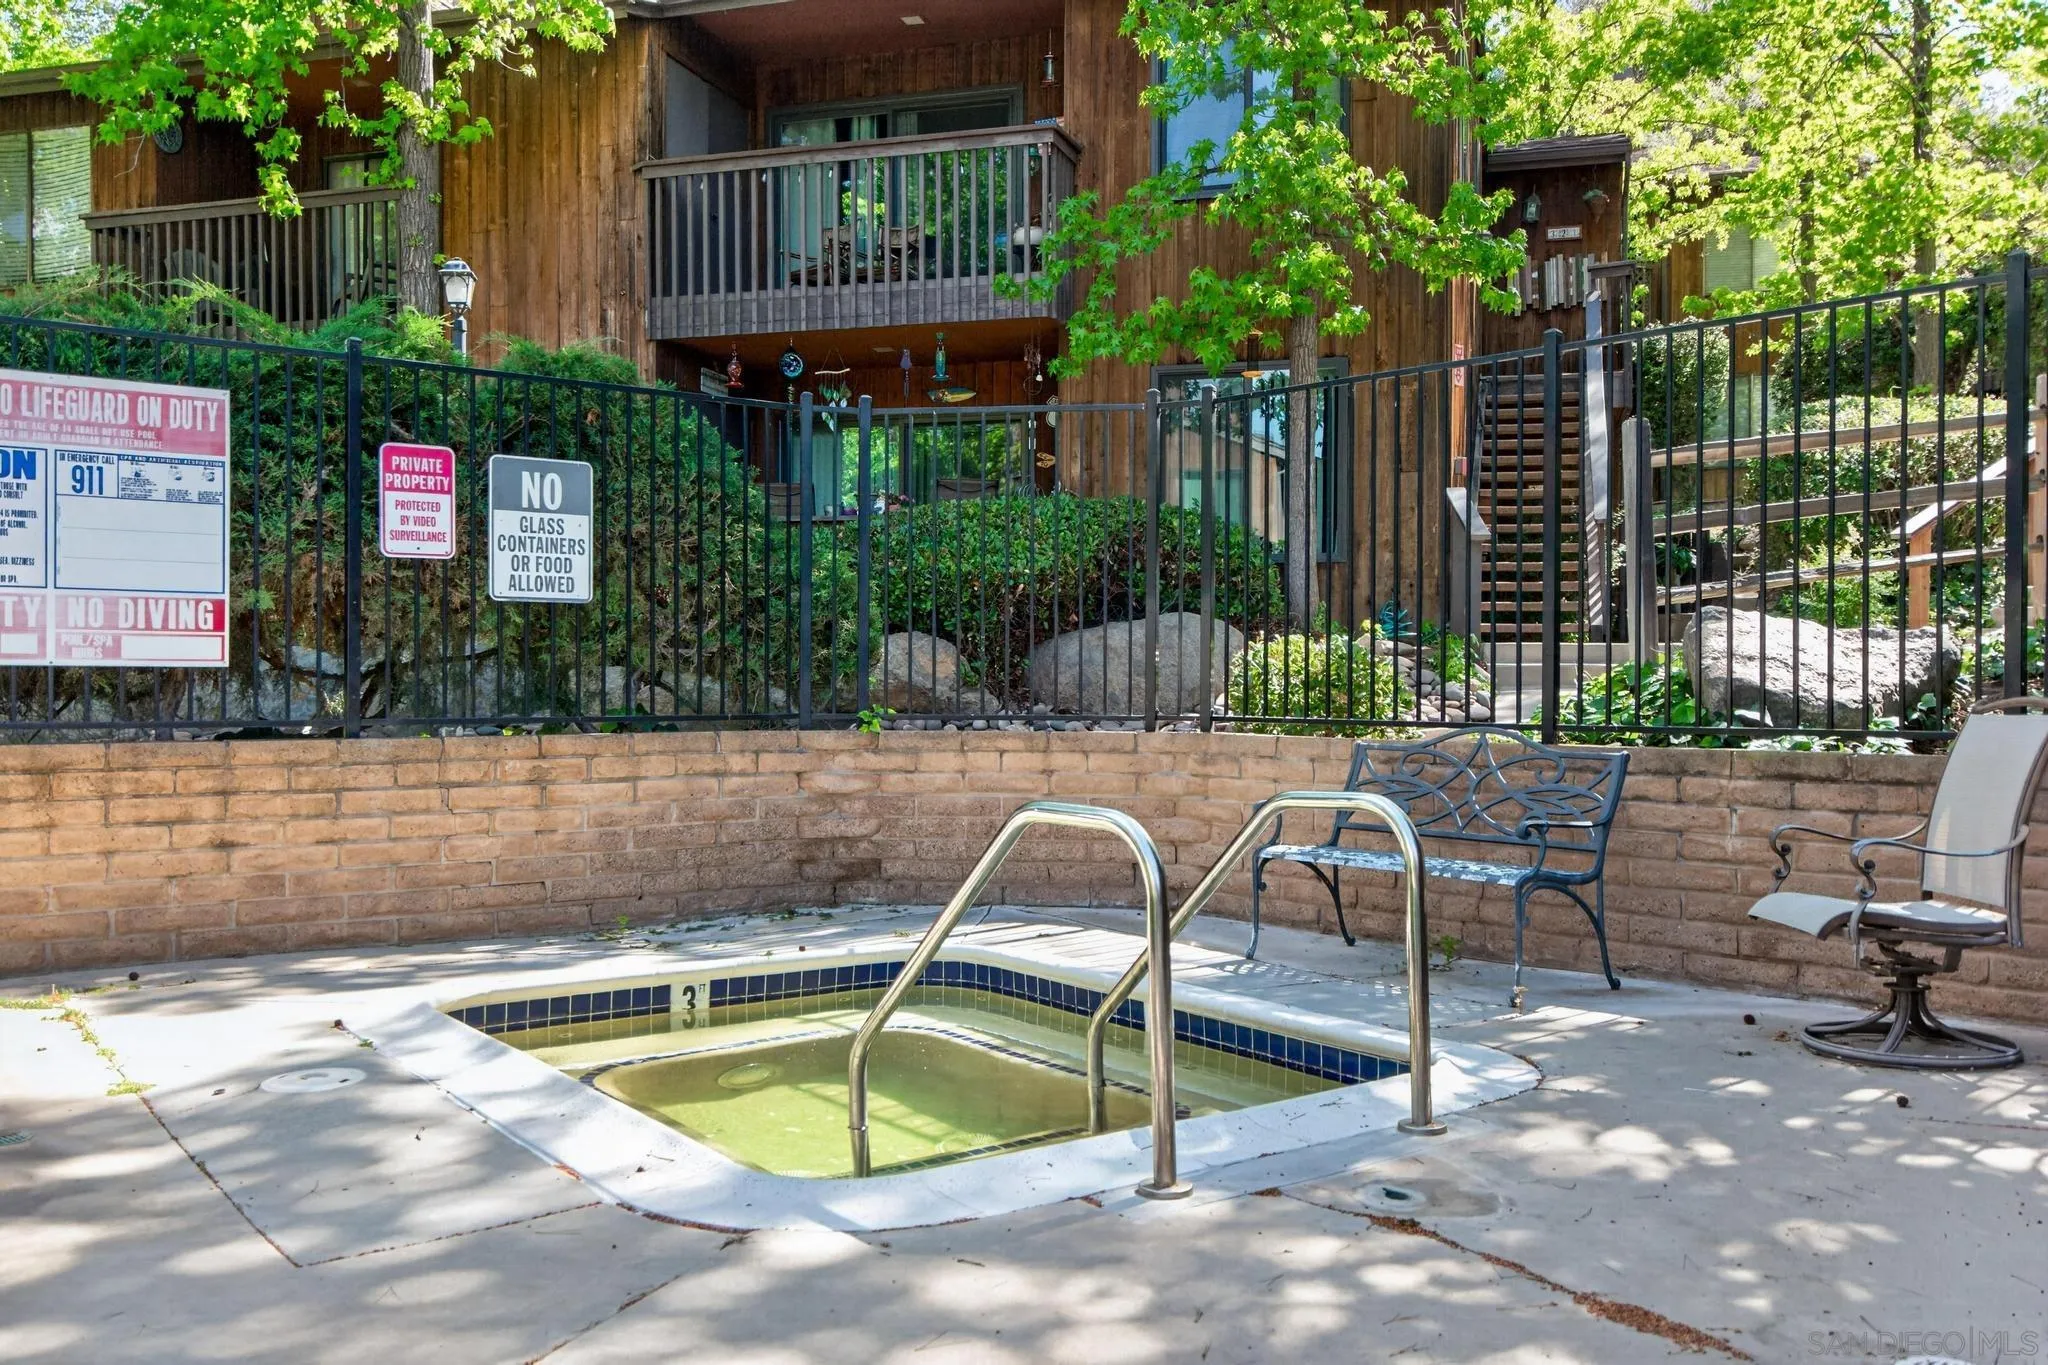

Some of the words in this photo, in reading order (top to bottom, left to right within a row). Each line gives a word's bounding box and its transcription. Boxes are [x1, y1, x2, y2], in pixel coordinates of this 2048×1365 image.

[20, 385, 129, 424] LIFEGUARD
[137, 396, 162, 428] ON
[170, 398, 218, 432] DUTY
[32, 422, 46, 430] AGE
[50, 424, 59, 432] OF
[75, 425, 98, 435] SHALL
[102, 428, 116, 436] NOT
[121, 429, 135, 437] USE
[68, 454, 99, 463] EMERGENCY
[102, 456, 114, 464] CALL
[392, 456, 442, 473] PRIVATE
[72, 465, 104, 495] 911
[385, 473, 450, 491] PROPERTY
[4, 491, 23, 499] CONSULT
[521, 471, 562, 510] NO
[395, 500, 441, 512] PROTECTED
[8, 520, 28, 528] ALCOHOL.
[400, 516, 410, 525] BY
[414, 516, 436, 527] VIDEO
[520, 516, 564, 535] GLASS
[390, 529, 447, 542] SURVEILLANCE
[498, 535, 585, 556] CONTAINERS
[12, 557, 34, 566] DIZZINESS
[511, 555, 530, 572] OR
[536, 556, 572, 573] FOOD
[509, 574, 574, 593] ALLOWED
[67, 597, 104, 628] NO
[118, 598, 214, 630] DIVING
[683, 985, 696, 1010] 3
[699, 984, 705, 992] FT
